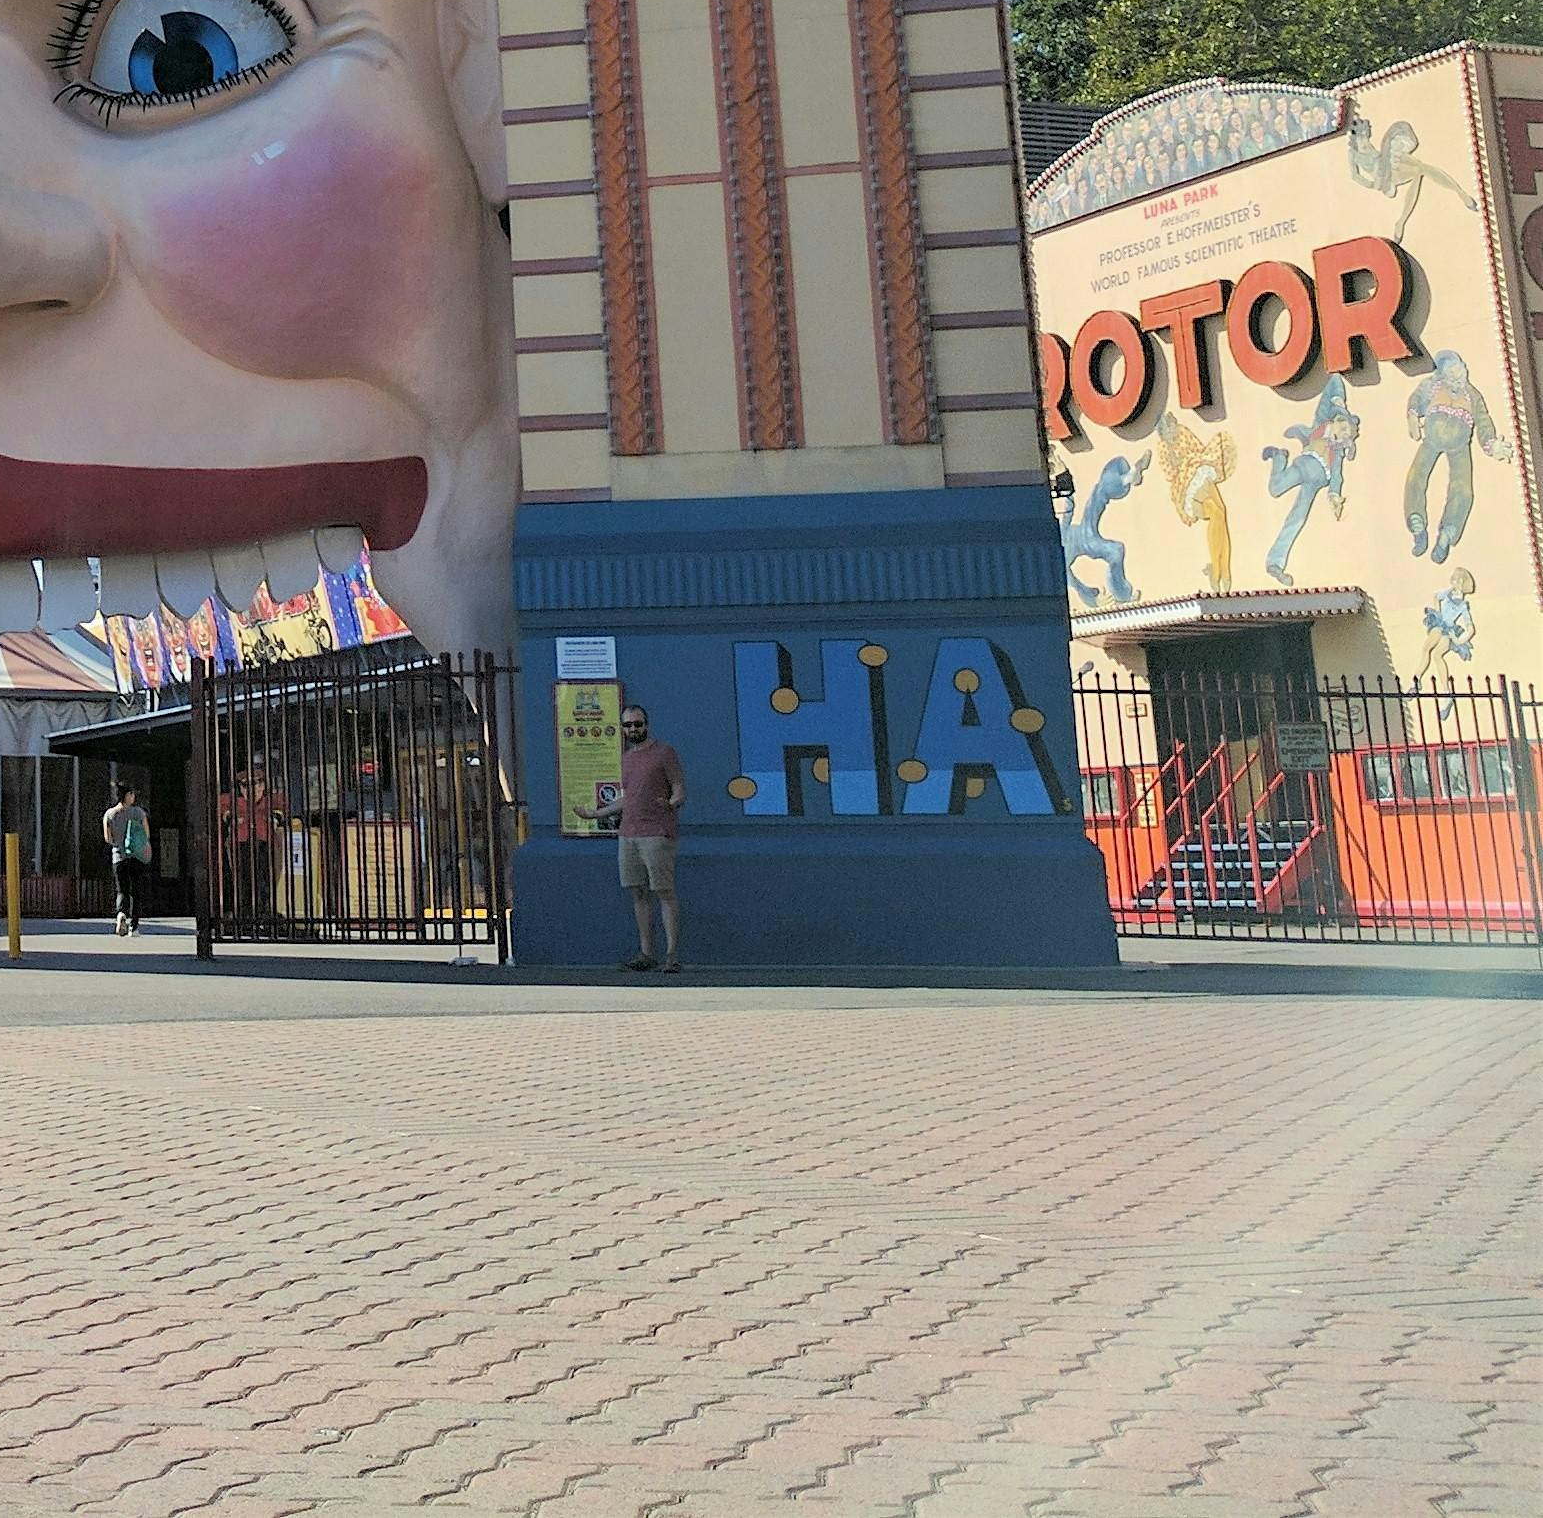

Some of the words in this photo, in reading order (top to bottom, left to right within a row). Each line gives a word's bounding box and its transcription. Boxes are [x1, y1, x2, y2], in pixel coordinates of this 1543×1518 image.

[1144, 197, 1178, 220] LUNA
[1184, 184, 1219, 206] PARK
[1160, 208, 1201, 229] PRESENTS
[1090, 272, 1130, 293] WORLD
[1137, 256, 1181, 279] FAMOUS
[1184, 235, 1244, 265] SCIENTIFIC
[1249, 218, 1297, 245] THEATRE
[1099, 236, 1161, 266] PROFESSOR
[732, 637, 1058, 816] HA
